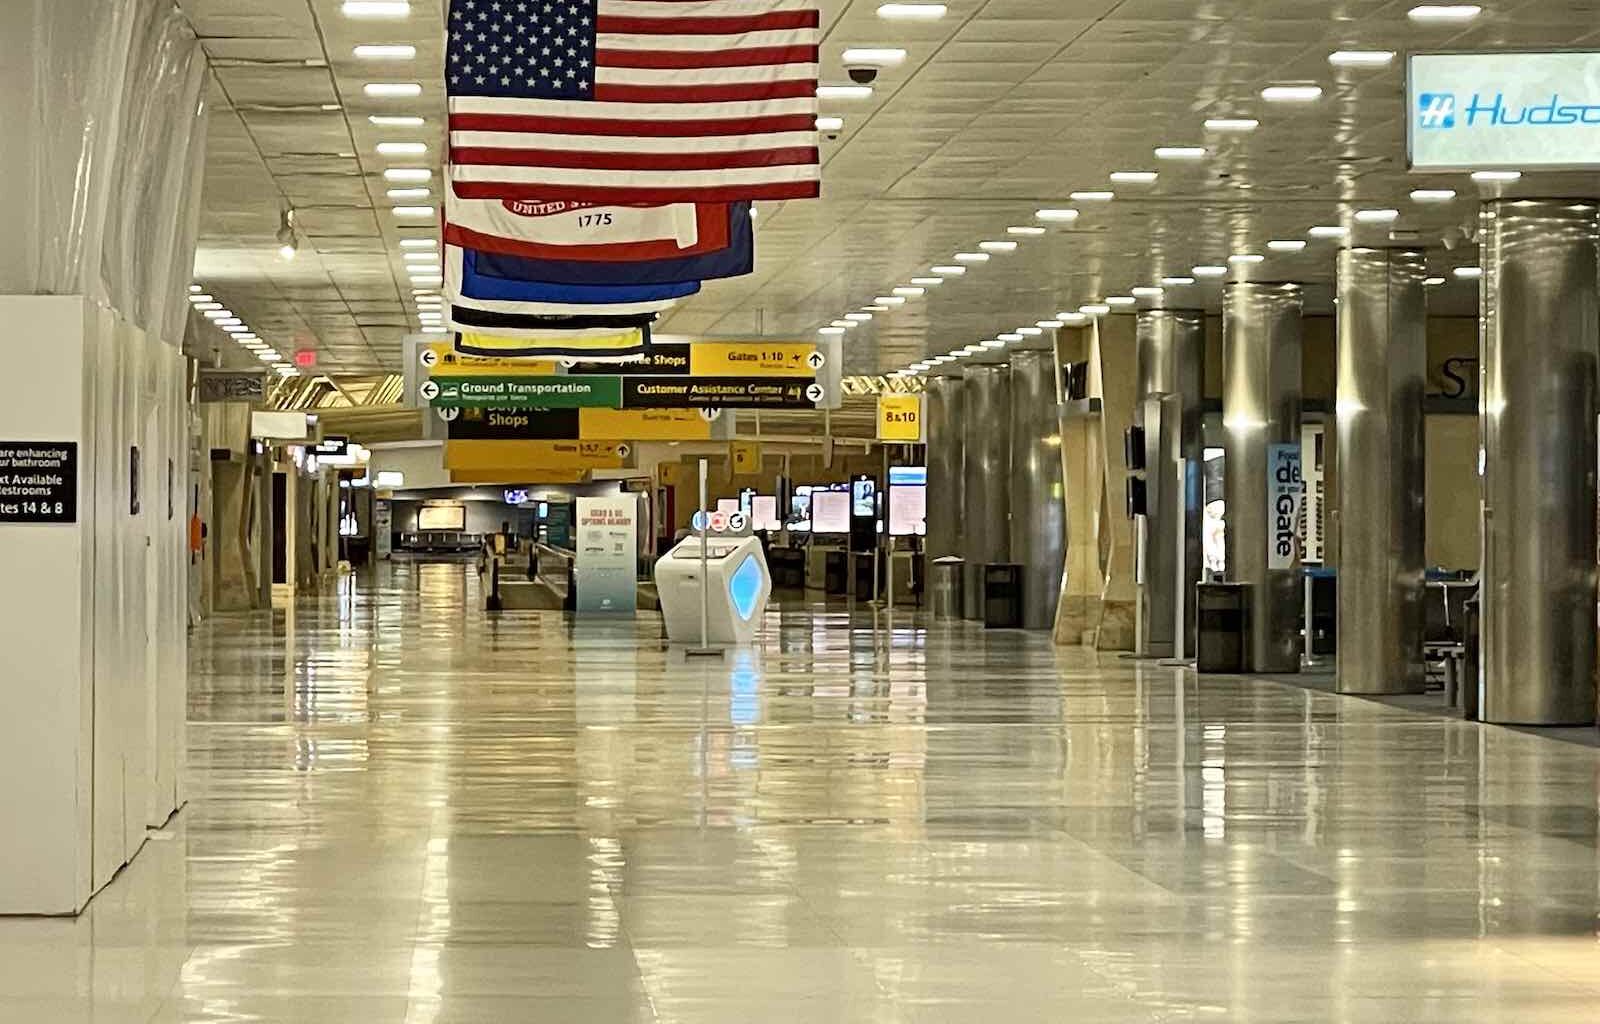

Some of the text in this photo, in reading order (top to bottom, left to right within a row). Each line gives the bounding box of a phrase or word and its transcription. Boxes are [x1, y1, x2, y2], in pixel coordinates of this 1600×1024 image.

[513, 201, 566, 214] UNITED
[578, 213, 613, 228] 1775
[655, 355, 686, 367] Shops
[728, 351, 758, 361] Gates
[461, 382, 592, 395] Ground Transportation
[637, 383, 783, 395] Customer Assistance Center
[489, 413, 529, 429] Shops
[16, 448, 68, 461] enhancing
[12, 458, 61, 467] bathroom
[12, 474, 63, 485] Available
[22, 502, 37, 514] 14
[40, 502, 51, 514] &
[54, 502, 64, 514] 8
[1276, 494, 1295, 557] Gate
